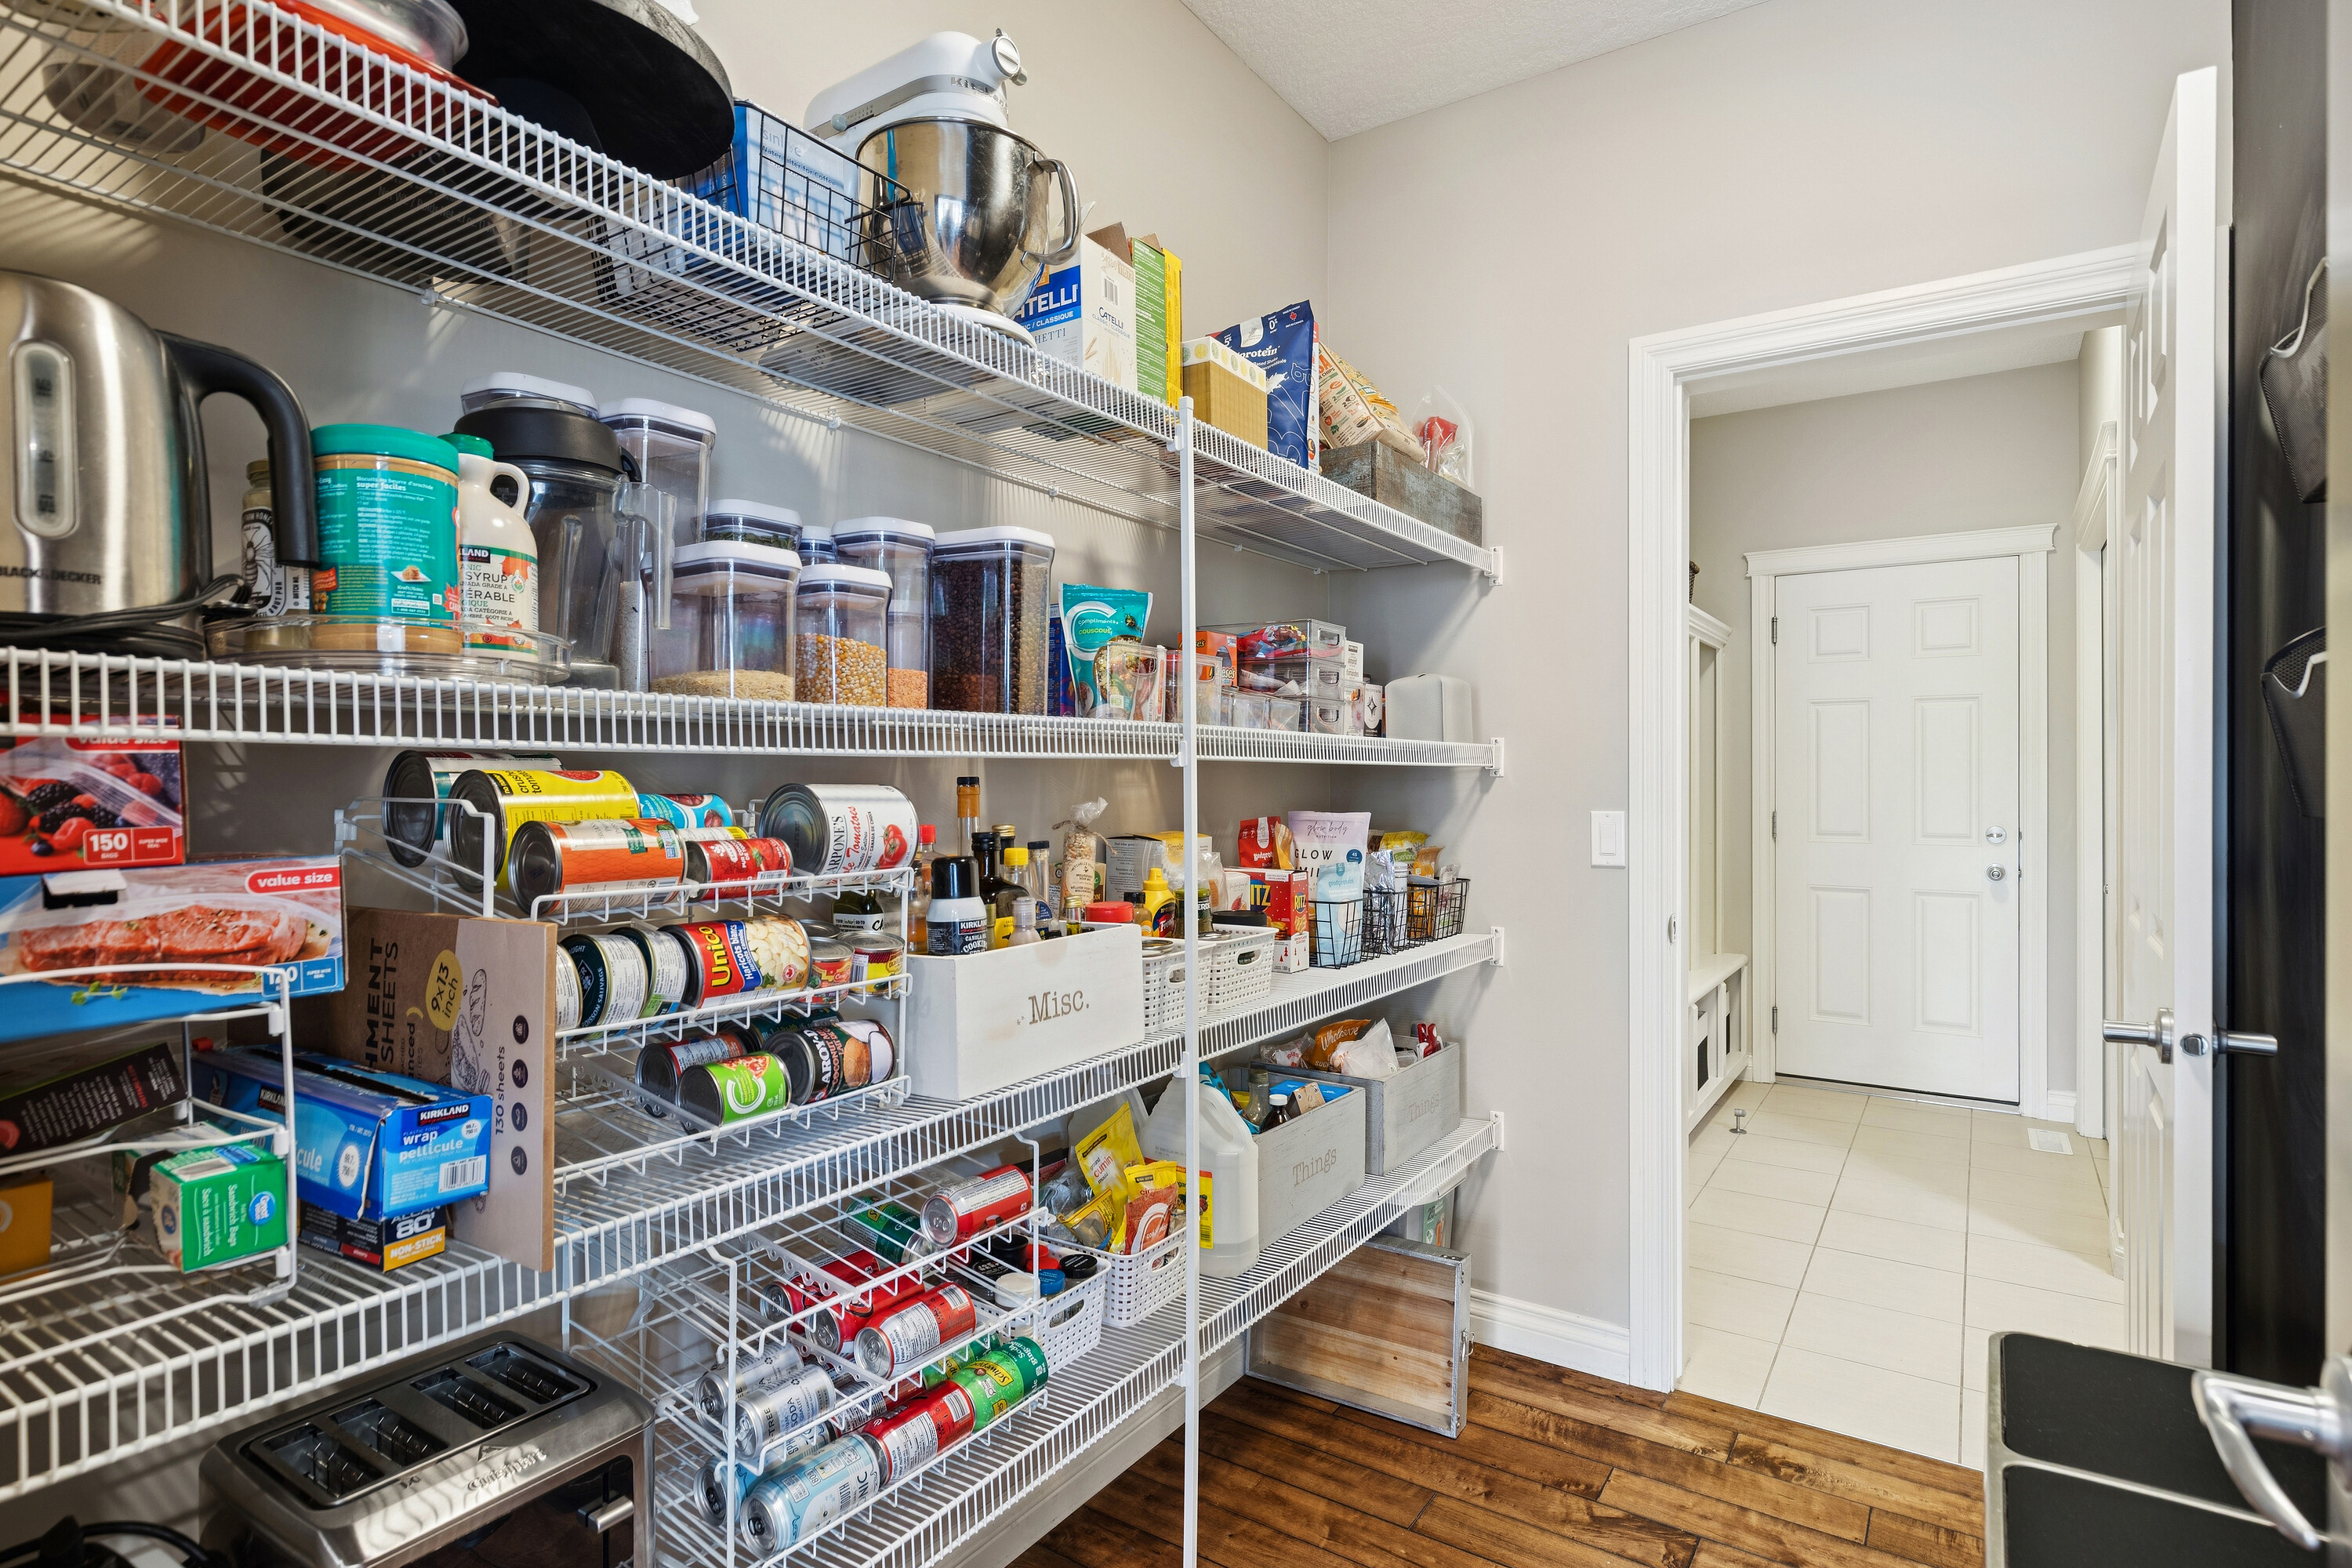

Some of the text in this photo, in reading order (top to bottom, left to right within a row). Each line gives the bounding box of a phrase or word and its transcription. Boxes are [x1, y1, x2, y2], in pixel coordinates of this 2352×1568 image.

[785, 158, 802, 170] ilter
[803, 165, 814, 175] for
[815, 169, 837, 187] Coffee
[1036, 311, 1074, 327] CLASSIQUE
[1098, 307, 1124, 330] CATELLI
[380, 481, 406, 491] faciles
[465, 572, 508, 583] SYRUP
[89, 833, 128, 851] 150
[846, 806, 858, 858] Tomatoes
[1307, 822, 1348, 836] glow body
[1294, 848, 1334, 860] GLOW
[257, 872, 333, 887] value size
[1294, 895, 1306, 909] RITZ
[698, 926, 731, 987] Unico
[730, 924, 754, 980] Haricots blancs
[431, 962, 449, 1011] 9x13
[441, 977, 458, 1019] inch
[381, 942, 398, 1064] SHEETS
[1028, 990, 1090, 1025] Misc.
[803, 1029, 831, 1084] AROY-D
[826, 1040, 840, 1085] COCONUT
[260, 1089, 285, 1107] KIRKLAN
[495, 1046, 505, 1135] 130 sheets
[420, 1104, 469, 1120] KIRKLAND
[1407, 1091, 1439, 1123] Things
[399, 1139, 463, 1164] pellicule
[403, 1131, 438, 1145] wrap
[296, 1147, 322, 1173] cule
[1090, 1157, 1101, 1171] ground
[1094, 1155, 1113, 1178] cumin
[1292, 1148, 1337, 1187] Things
[227, 1184, 239, 1247] Sandwich Bags
[203, 1216, 214, 1257] sandwich
[390, 1233, 442, 1259] NON-STICK
[787, 1397, 798, 1427] SODA
[467, 1447, 548, 1490] Cuisinart
